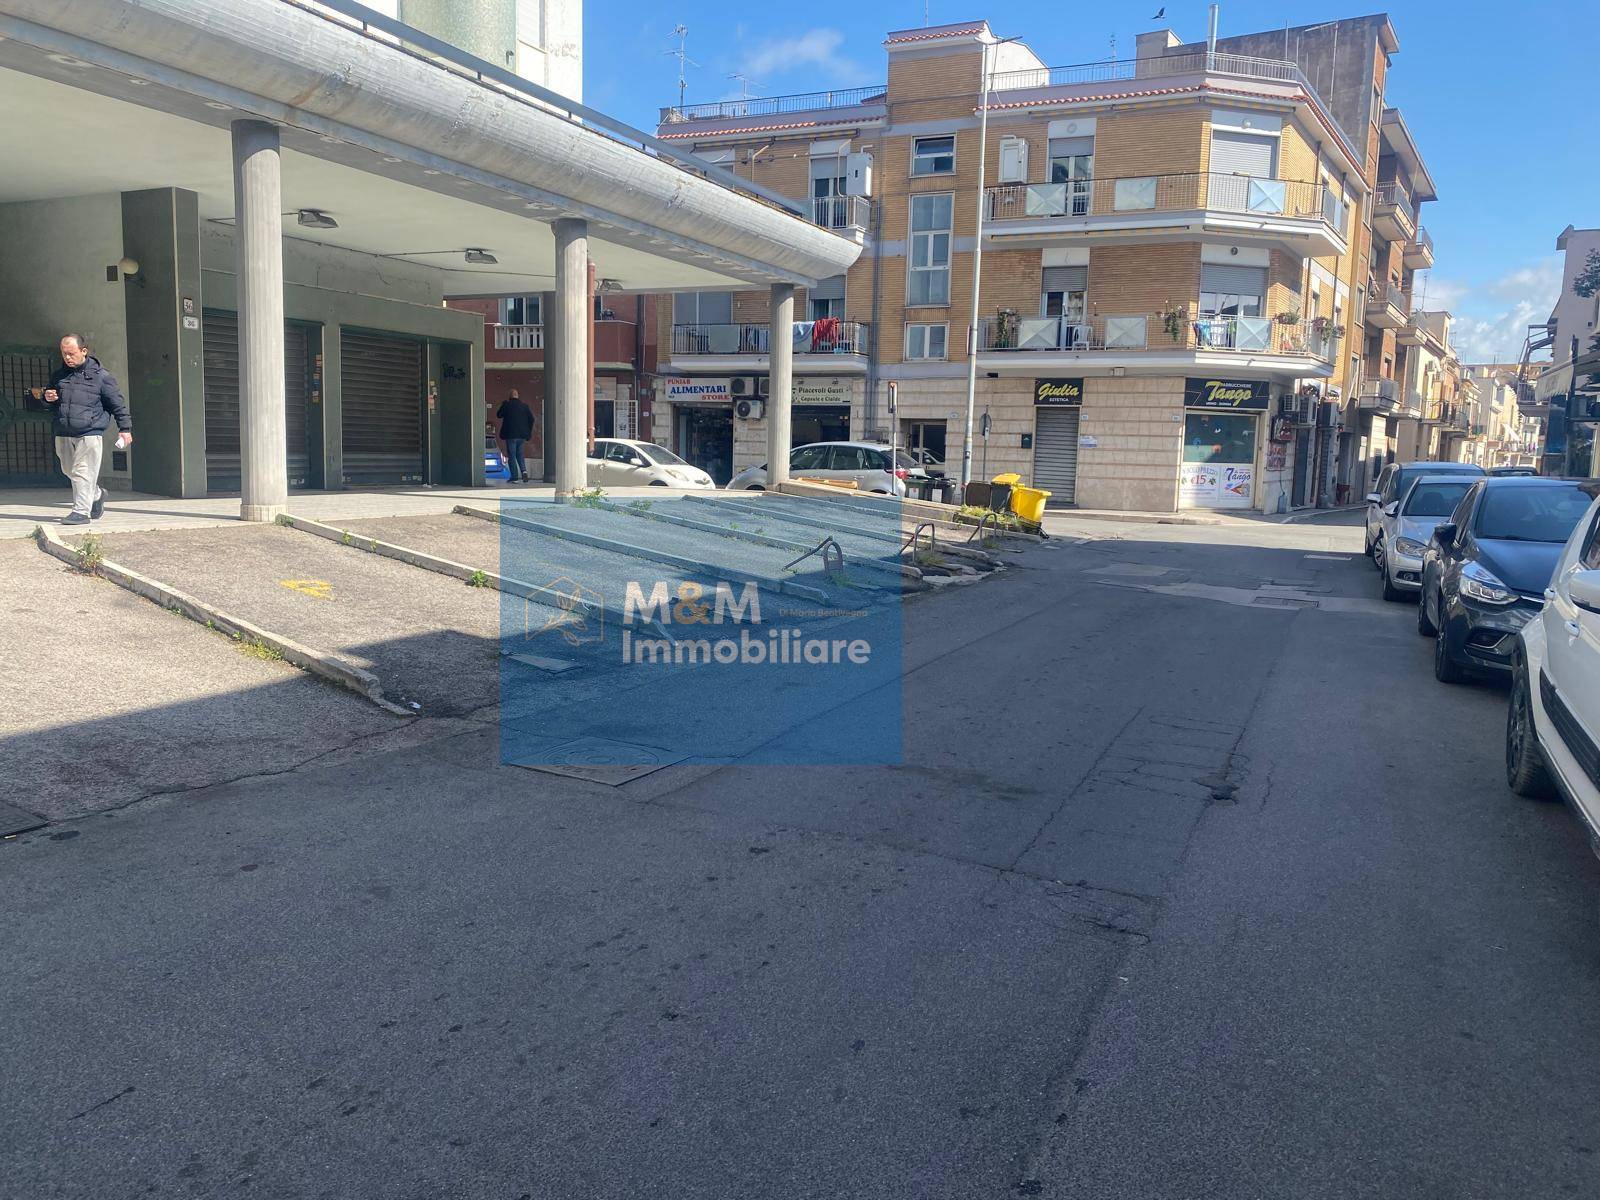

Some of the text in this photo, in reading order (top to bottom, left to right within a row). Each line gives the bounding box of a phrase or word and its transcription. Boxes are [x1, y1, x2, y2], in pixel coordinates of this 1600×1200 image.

[670, 385, 727, 394] ALIMENTARI
[1038, 383, 1079, 401] Giulia
[1205, 381, 1252, 406] Tango
[1226, 467, 1251, 483] Tango
